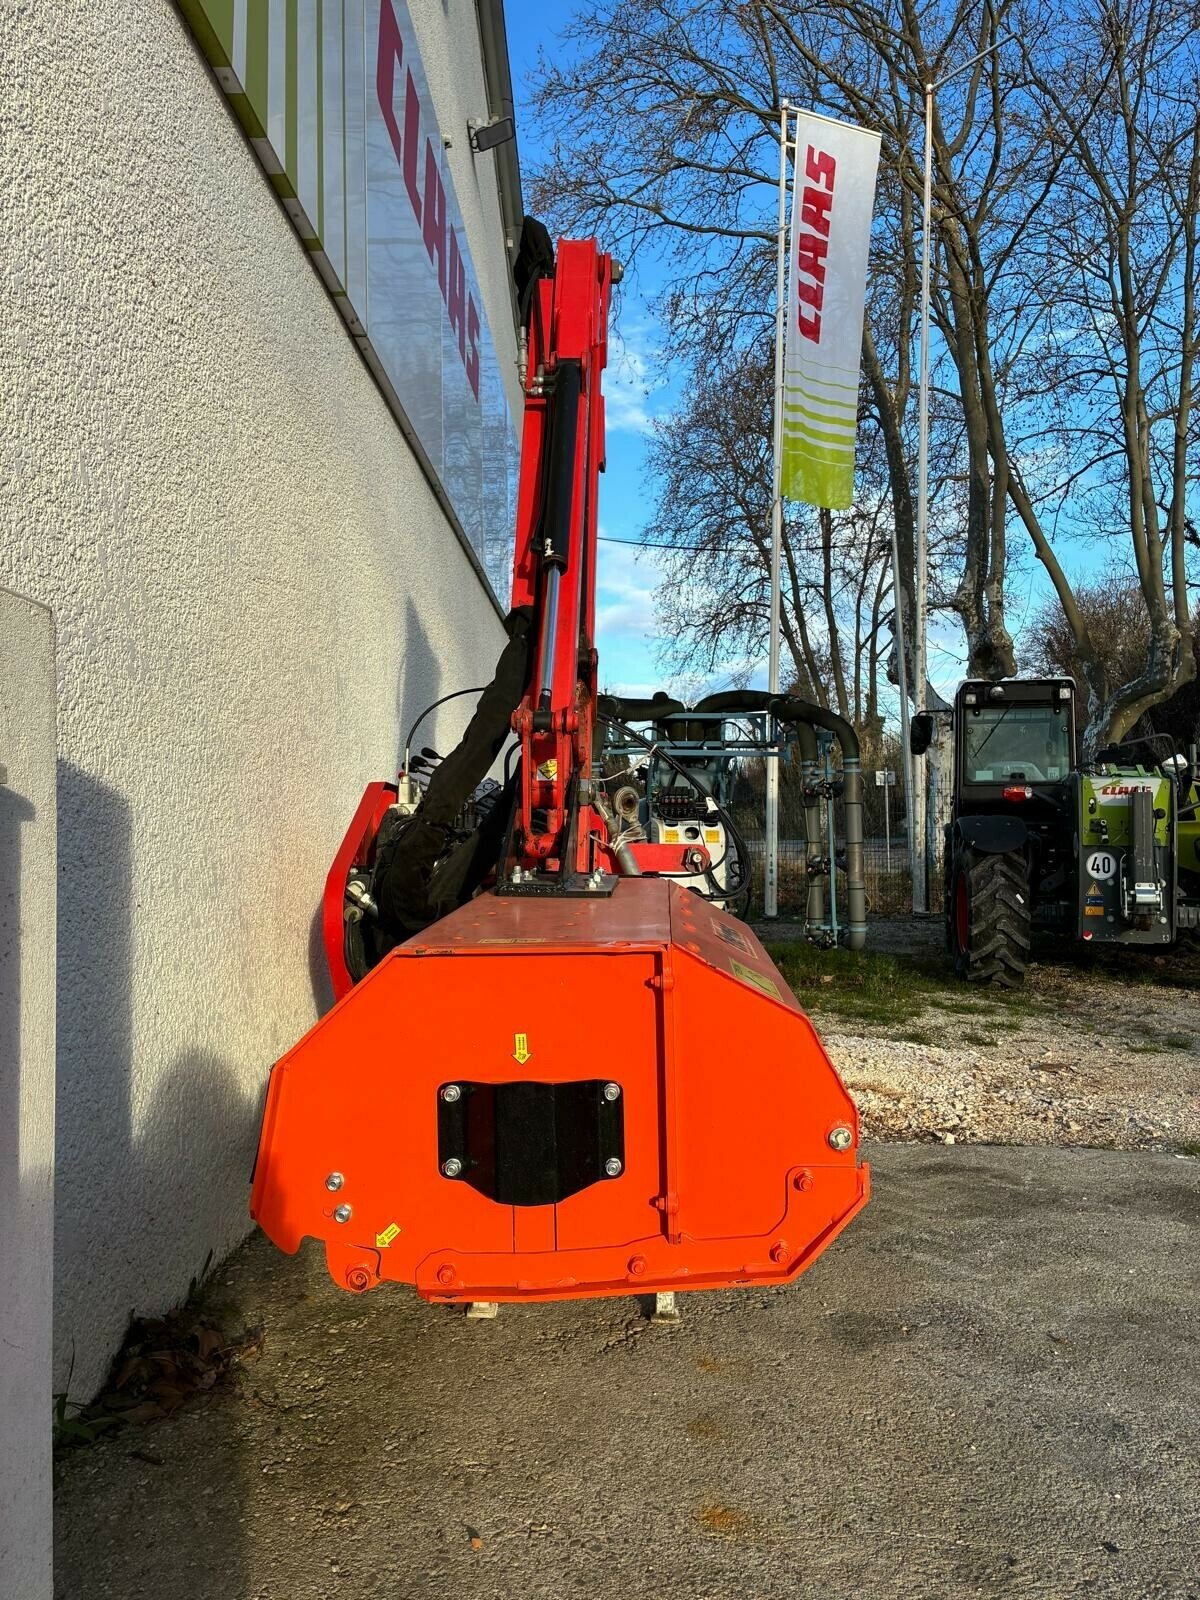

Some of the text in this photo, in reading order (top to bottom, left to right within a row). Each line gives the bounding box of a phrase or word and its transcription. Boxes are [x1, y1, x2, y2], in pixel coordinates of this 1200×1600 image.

[377, 0, 480, 403] CLAAS
[798, 144, 837, 344] CLAAS
[1091, 856, 1111, 874] 40
